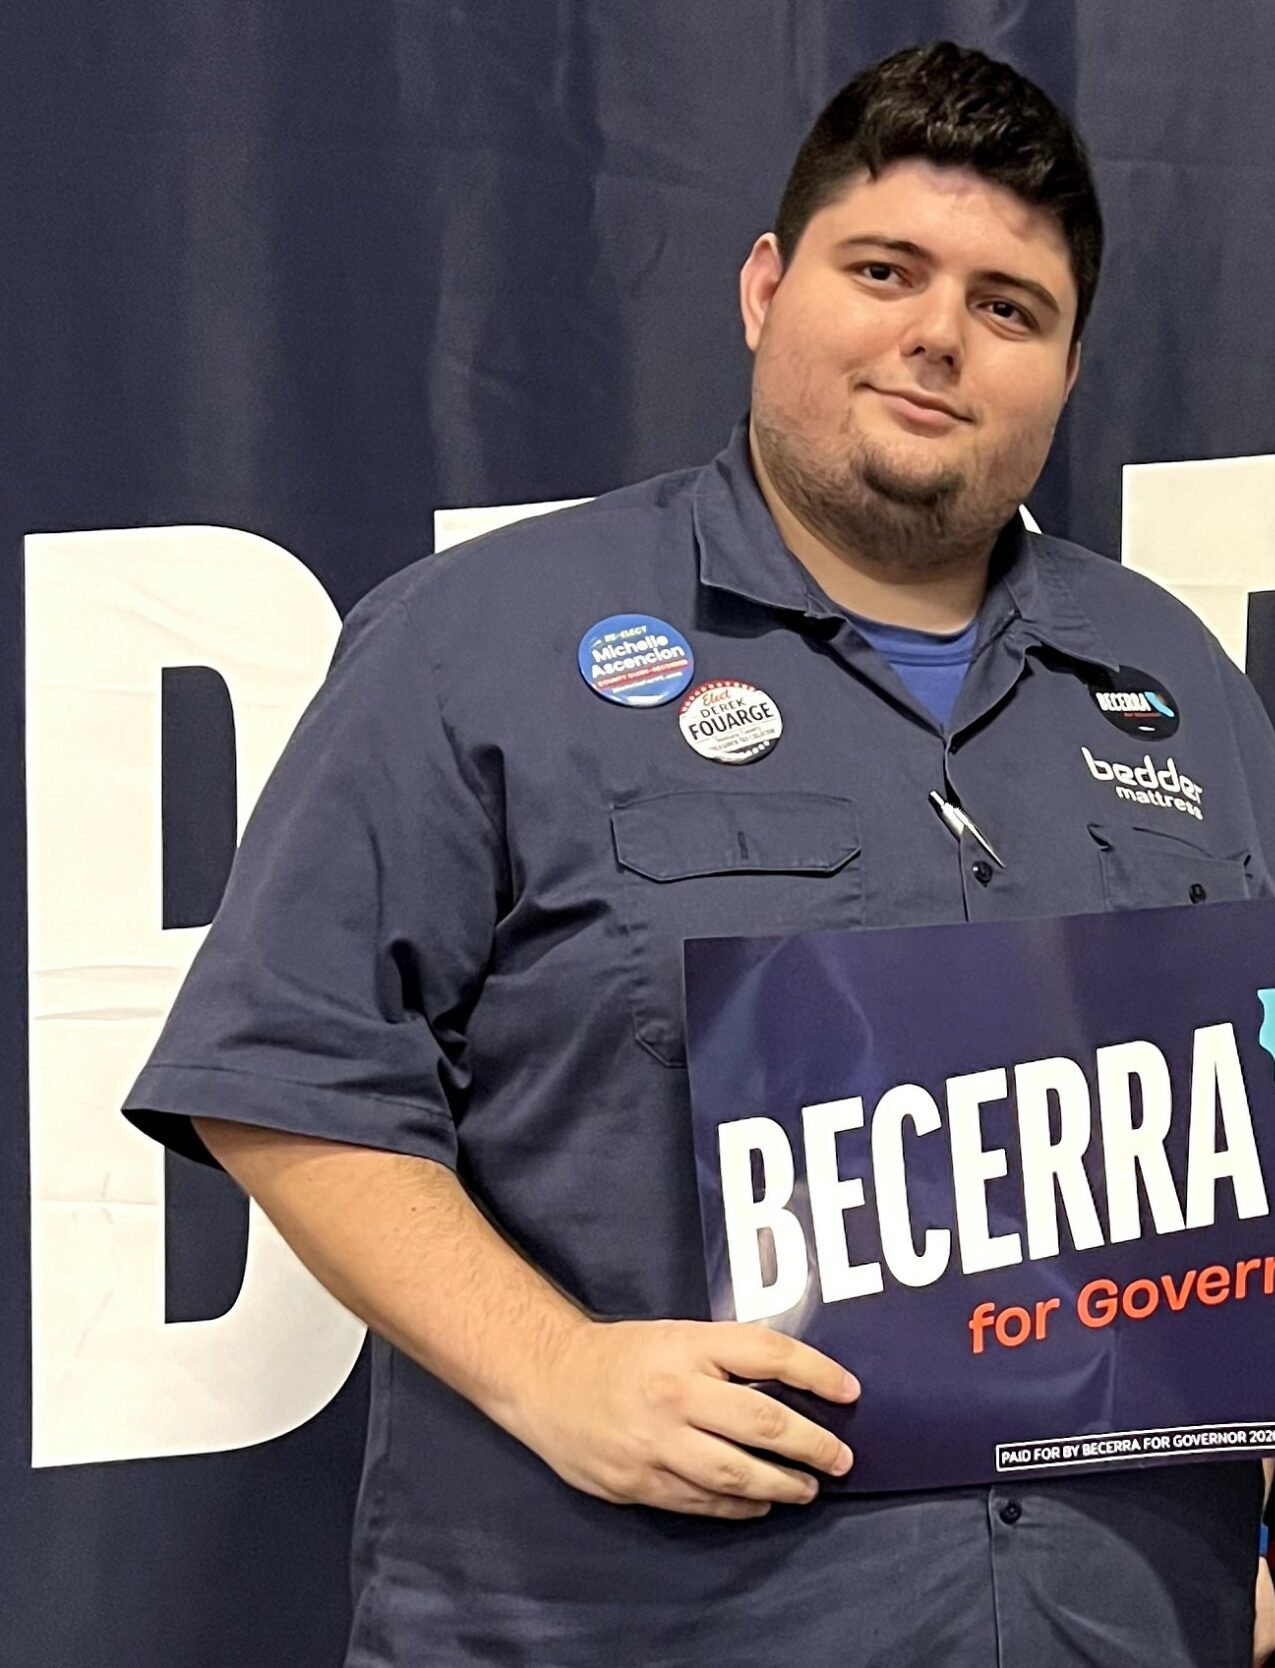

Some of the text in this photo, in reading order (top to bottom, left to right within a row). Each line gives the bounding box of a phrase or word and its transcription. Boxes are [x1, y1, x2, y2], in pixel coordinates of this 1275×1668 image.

[591, 645, 686, 679] Ascencion
[592, 635, 669, 662] Michelle
[699, 697, 747, 718] DEREK
[702, 688, 732, 707] Elect
[688, 702, 774, 740] FOUARGE
[1081, 746, 1203, 804] bedder
[1115, 786, 1203, 820] mattress
[717, 1021, 1270, 1323] BECERRA
[968, 1298, 1060, 1354] for
[1001, 1449, 1032, 1465] PAID
[1033, 1447, 1061, 1461] FOR
[1062, 1444, 1080, 1458] BY
[1082, 1438, 1141, 1457] BECERRA
[1143, 1435, 1170, 1450] FOR
[1172, 1430, 1247, 1448] GOVERNOR
